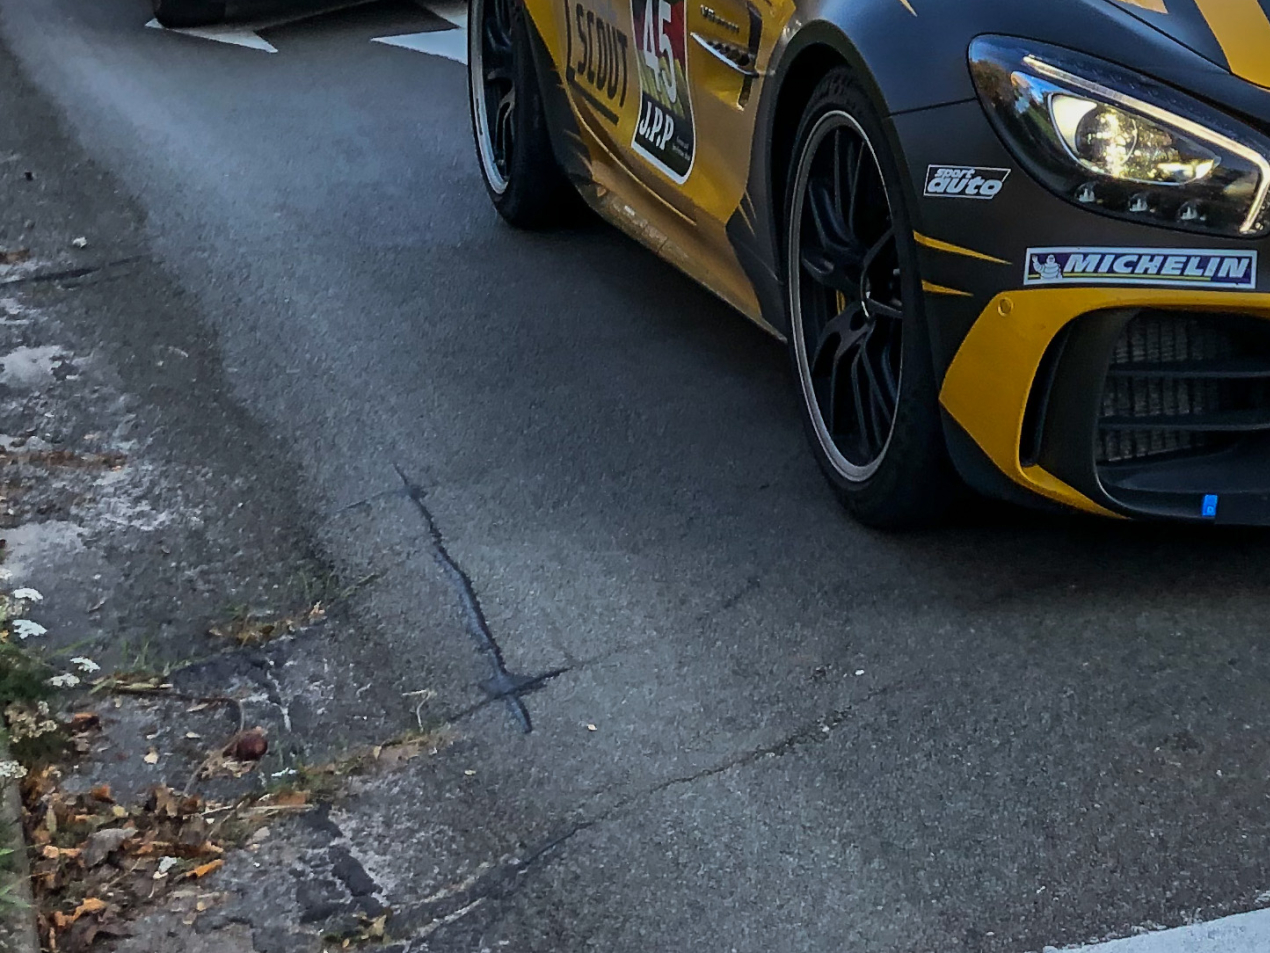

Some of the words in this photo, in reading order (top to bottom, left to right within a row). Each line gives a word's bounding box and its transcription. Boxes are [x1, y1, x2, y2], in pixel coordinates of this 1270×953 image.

[575, 3, 628, 108] SCOUT
[639, 101, 675, 151] J.P.P
[927, 177, 1003, 195] auto
[935, 168, 975, 180] sport
[1063, 253, 1251, 278] MICHELIN
